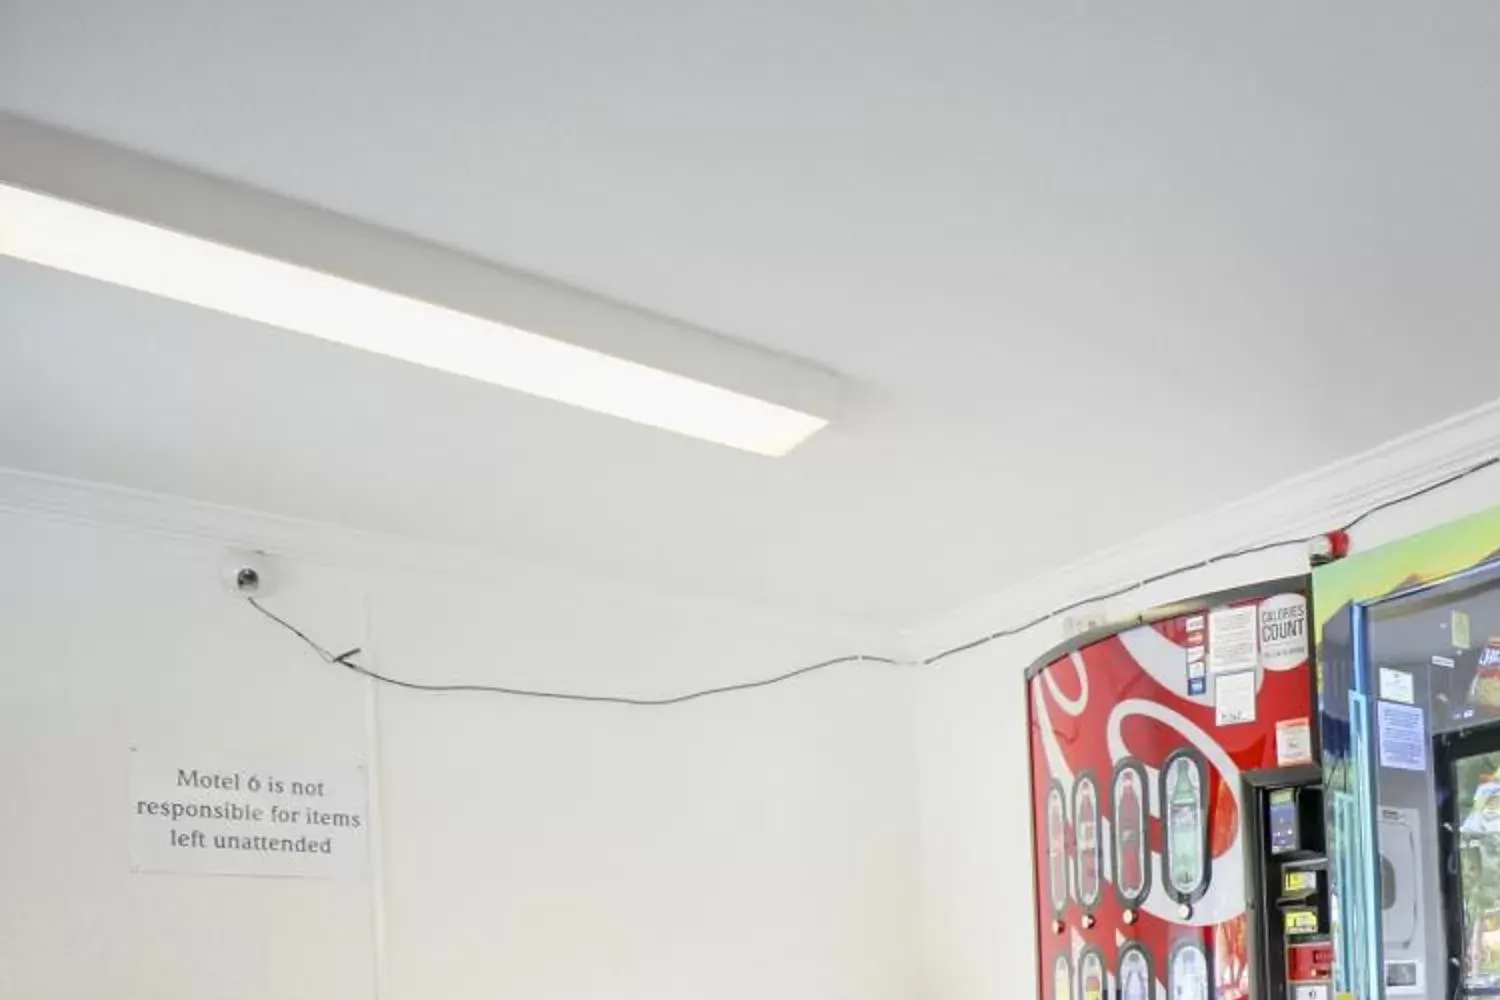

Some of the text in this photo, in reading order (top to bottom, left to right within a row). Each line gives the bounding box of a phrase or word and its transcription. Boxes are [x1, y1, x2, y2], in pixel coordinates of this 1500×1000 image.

[1262, 603, 1305, 624] CALORIES
[1262, 619, 1305, 642] COUNT
[176, 768, 324, 797] Motel 6 is not
[136, 799, 362, 828] responsible for items
[170, 829, 333, 854] left unattended
